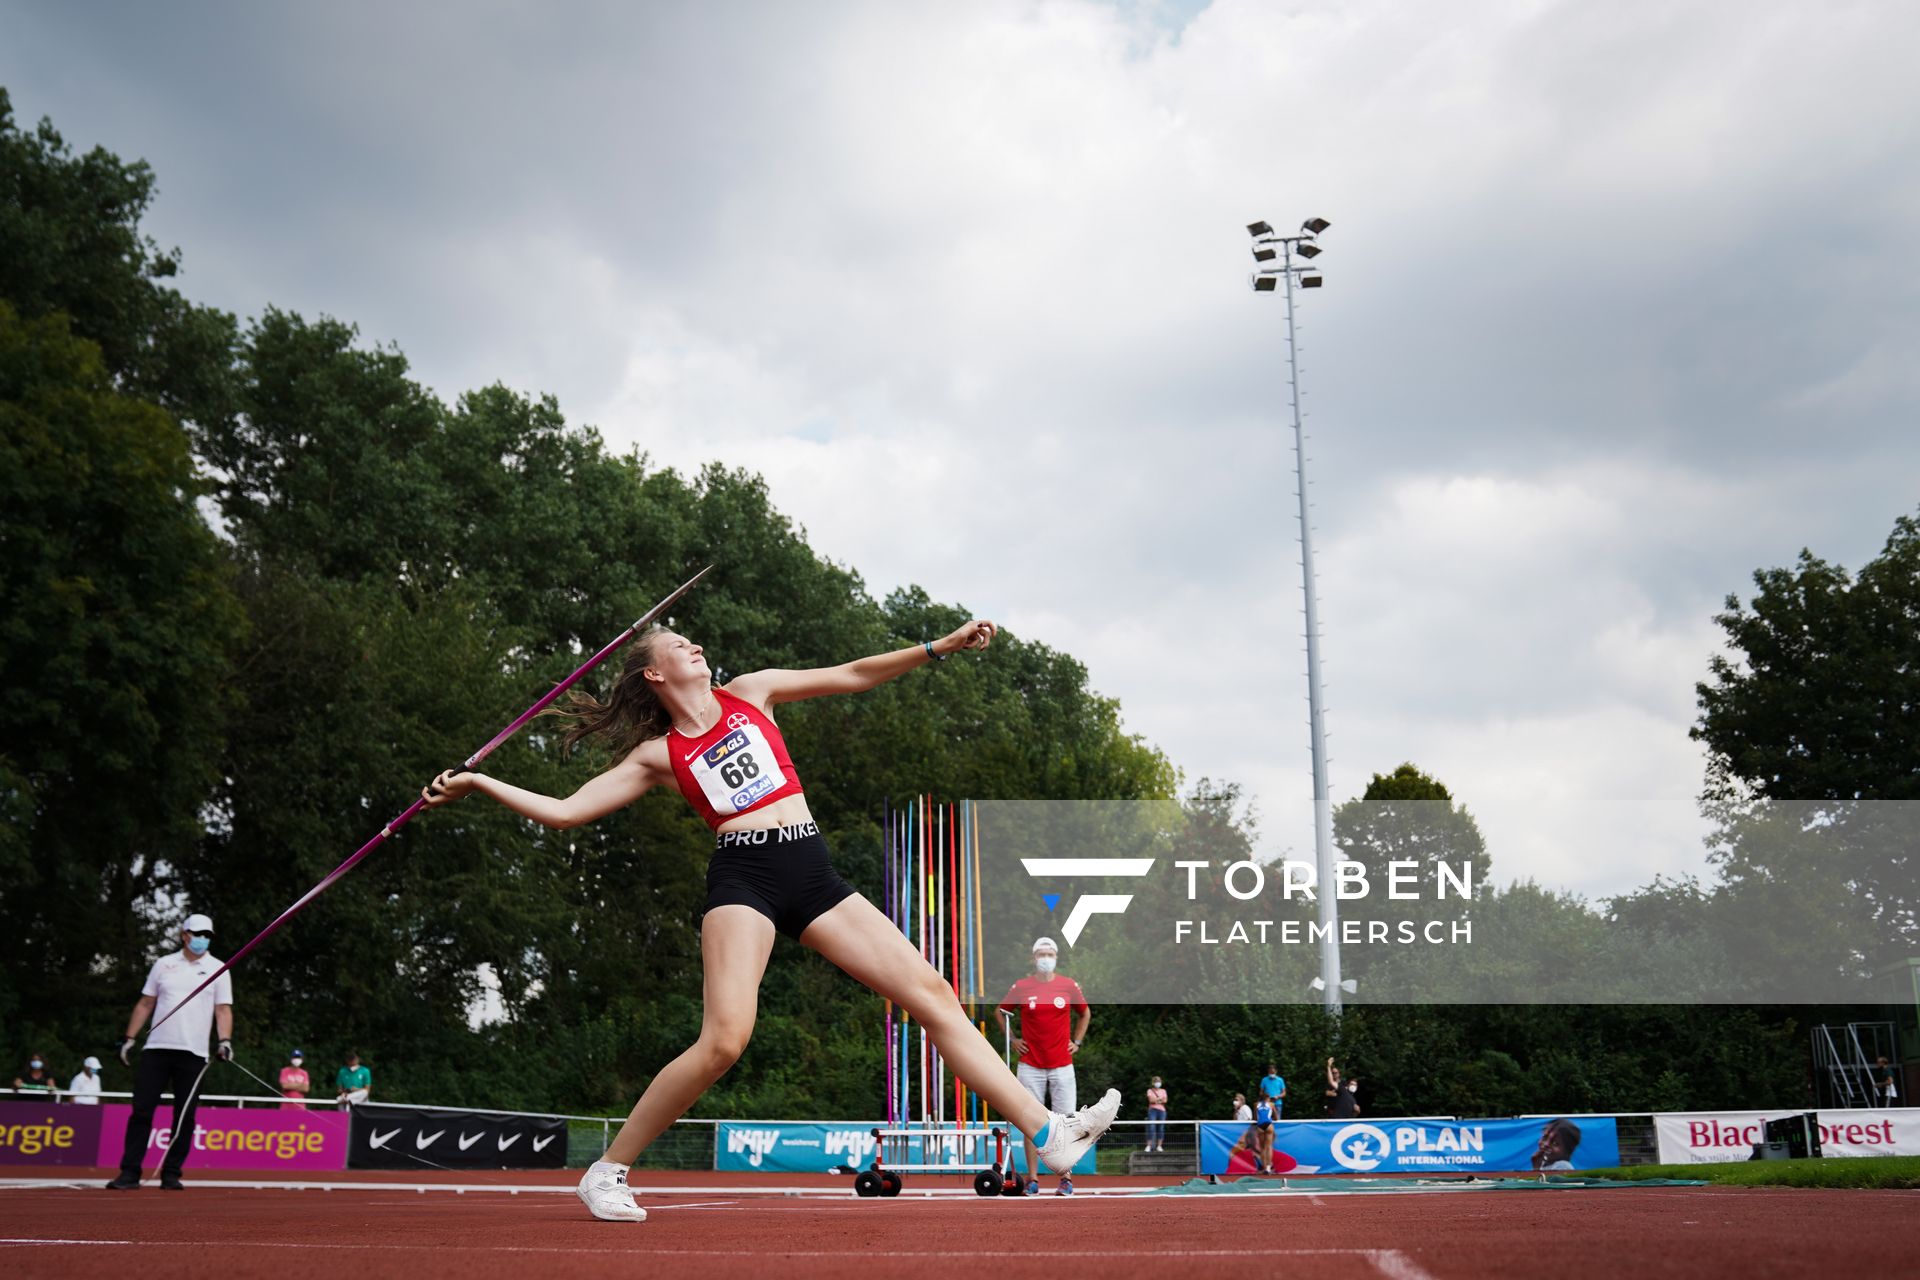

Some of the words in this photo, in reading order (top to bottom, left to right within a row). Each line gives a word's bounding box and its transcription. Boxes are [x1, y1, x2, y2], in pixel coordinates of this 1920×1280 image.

[727, 734, 745, 751] GLS
[720, 752, 760, 789] 68
[748, 777, 772, 796] PLAN
[724, 829, 768, 848] PRO
[778, 822, 817, 843] NIKE
[0, 1117, 75, 1154] rgie
[147, 1124, 324, 1159] etenergie
[1396, 1127, 1484, 1152] PLAN
[1818, 1119, 1896, 1144] orest
[1398, 1156, 1485, 1164] INTERNATIONAL
